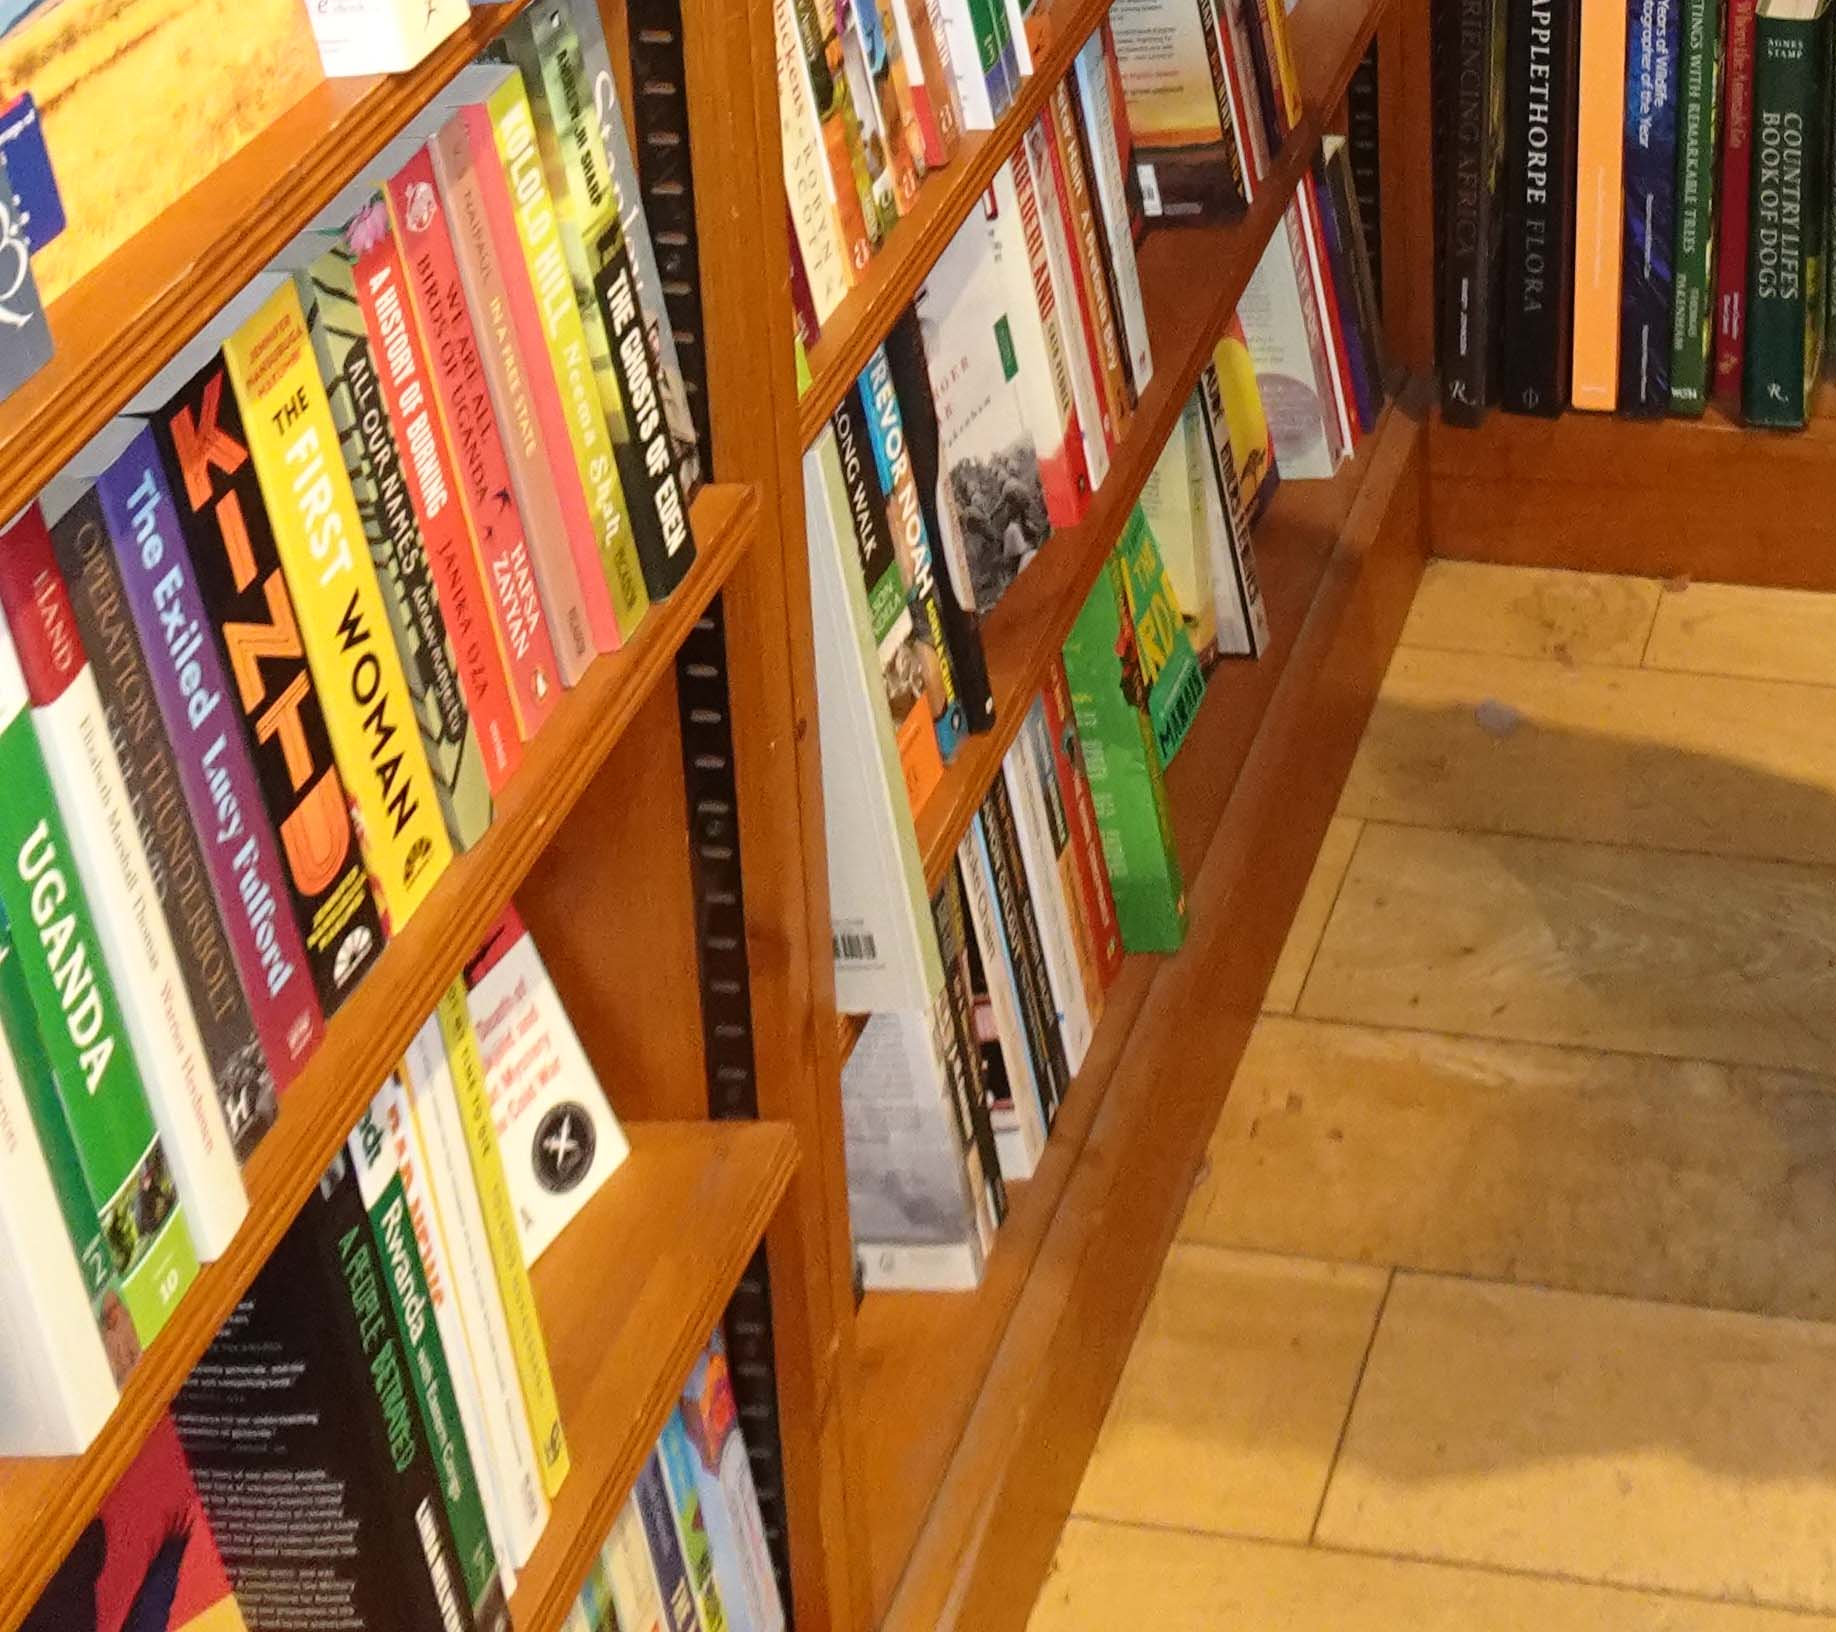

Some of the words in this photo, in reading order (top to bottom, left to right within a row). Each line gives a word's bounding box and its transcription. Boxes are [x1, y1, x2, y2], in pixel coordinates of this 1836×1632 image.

[1761, 112, 1781, 180] BOOK
[1779, 112, 1803, 226] COUNTRY
[496, 102, 544, 242] KOLOLO
[531, 245, 571, 340] HILL
[1760, 188, 1780, 220] OF
[369, 267, 380, 290] A
[607, 268, 633, 325] THE
[1758, 227, 1779, 298] DOGS
[372, 289, 414, 384] HISTORY
[272, 386, 309, 436] THE
[400, 384, 419, 415] OF
[620, 330, 659, 441] GHOSTS
[406, 417, 448, 520] BURNING
[646, 441, 668, 477] OF
[283, 426, 352, 588] FIRST
[655, 479, 686, 557] EDEN
[126, 469, 165, 567] The
[153, 575, 219, 732] Exiled
[201, 734, 242, 843] Lucy
[231, 838, 294, 997] Fulford
[335, 588, 421, 841] WOMAN
[17, 820, 107, 1095] UGANDA
[381, 1195, 427, 1348] Rwanda
